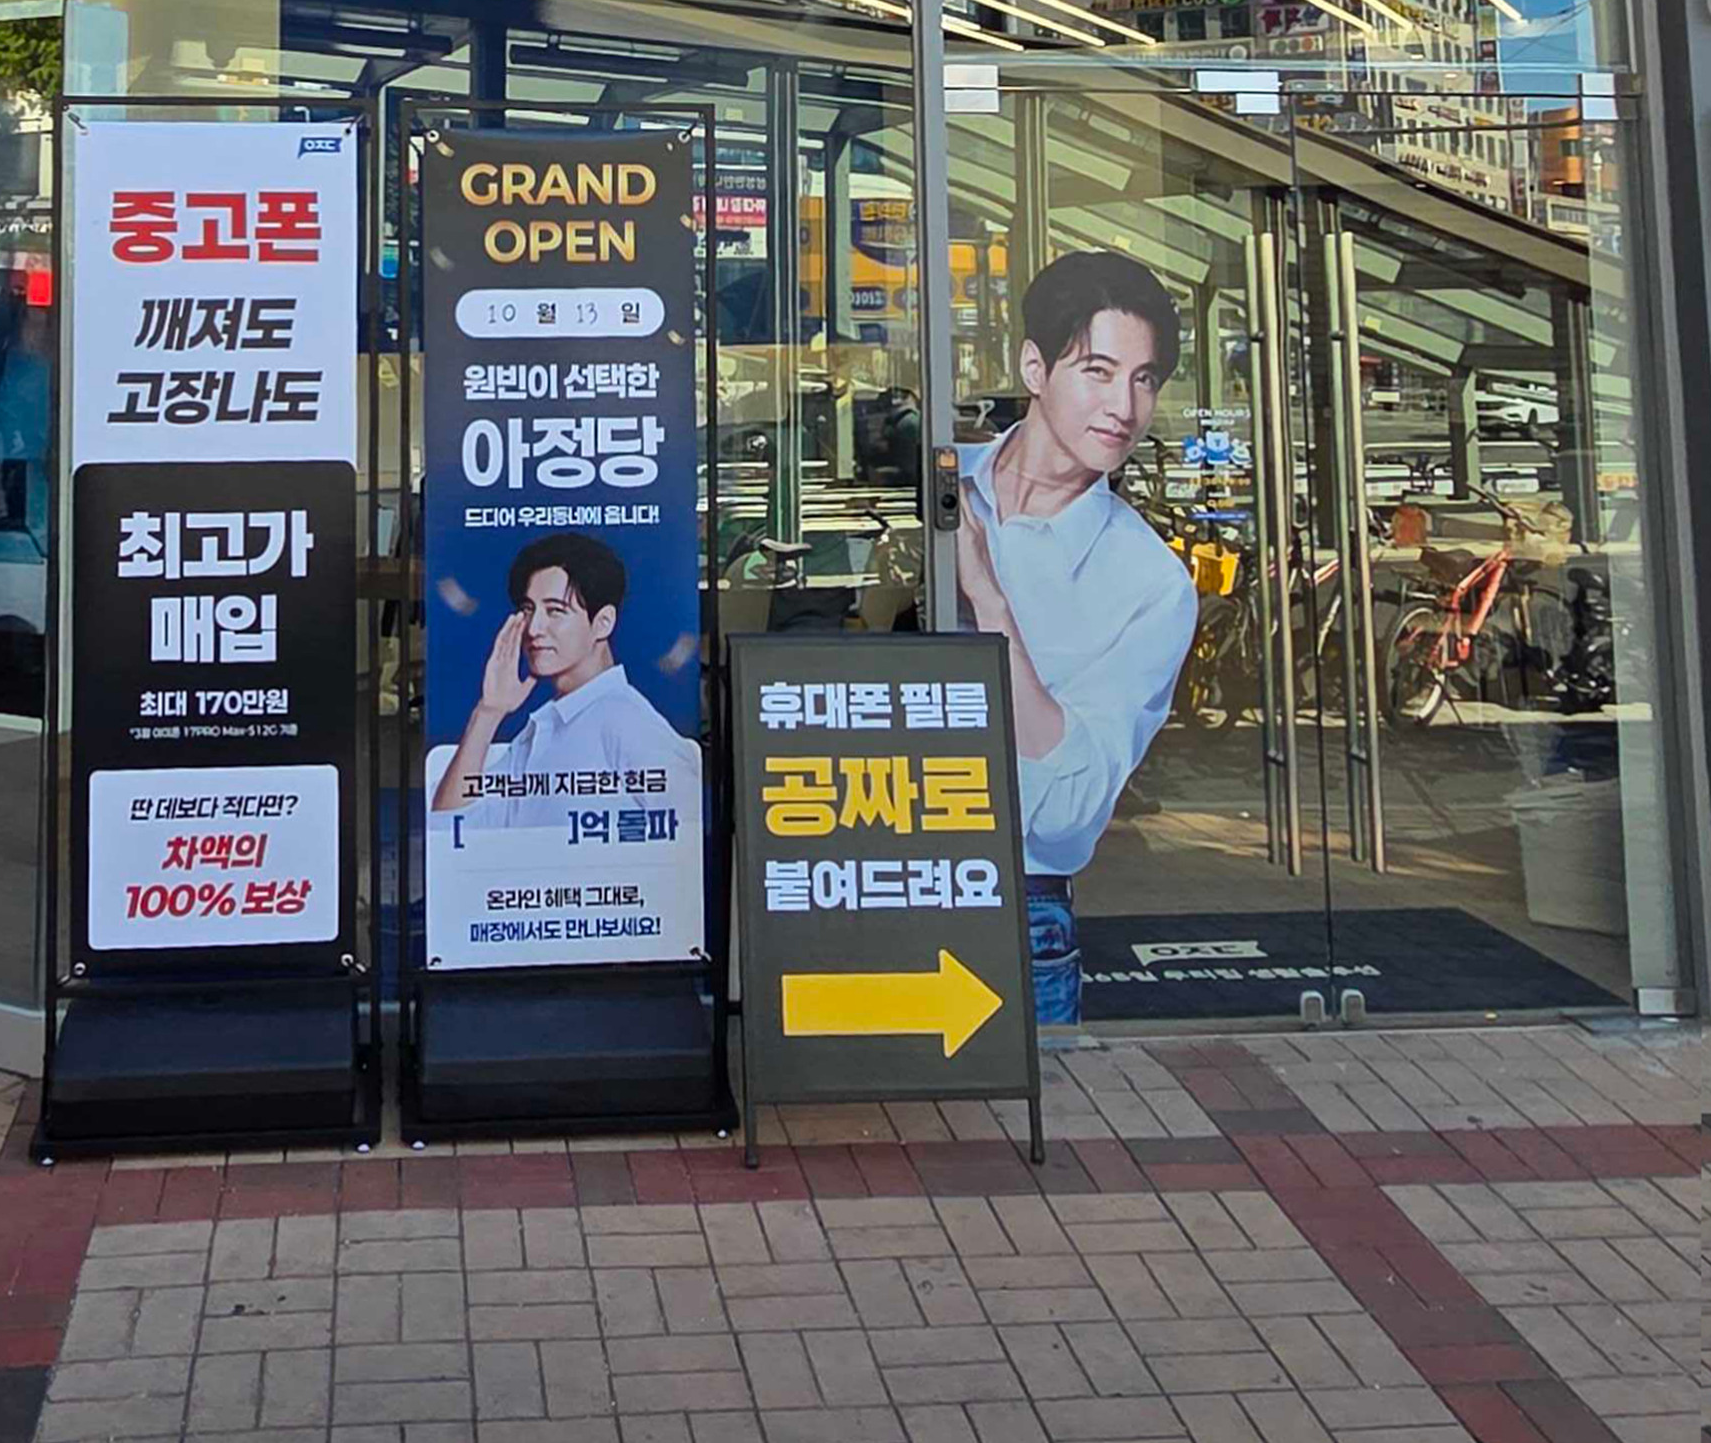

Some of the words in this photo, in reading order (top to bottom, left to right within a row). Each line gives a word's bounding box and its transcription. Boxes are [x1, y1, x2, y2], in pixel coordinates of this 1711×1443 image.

[460, 162, 657, 207] GRAND
[109, 191, 322, 264] 중고폰
[484, 219, 636, 263] OPEN
[134, 298, 297, 351] 깨져도
[487, 303, 517, 324] 10
[536, 302, 557, 325] 월
[620, 301, 641, 325] 일
[106, 370, 323, 425] 고장나도
[463, 363, 558, 401] 원빈이
[563, 362, 660, 400] 선택한
[461, 415, 665, 489] 아정당
[464, 507, 515, 528] 드디어
[517, 506, 601, 527] 우리동네에
[117, 510, 314, 580] 최고가
[151, 594, 277, 663] 매입
[140, 690, 187, 717] 최대
[195, 689, 289, 716] 170만원
[759, 681, 892, 730] 휴대폰
[899, 682, 989, 730] 필름
[461, 772, 550, 799] 고객님께
[554, 770, 620, 796] 지급한
[623, 769, 667, 794] 현금
[762, 756, 996, 837] 공짜로
[130, 798, 152, 821] 딴
[155, 796, 220, 820] 데보다
[223, 795, 299, 818] 적다면?
[616, 808, 679, 844] 돌파
[161, 833, 268, 871] 차액의
[126, 882, 237, 919] 100%
[241, 880, 312, 915] 보상
[486, 888, 541, 911] 온라인
[544, 887, 582, 909] 혜택
[585, 885, 645, 908] 그대로,
[764, 858, 1003, 911] 붙여드려요
[470, 919, 561, 943] 매장에서도
[565, 916, 662, 940] 만나보세요!
